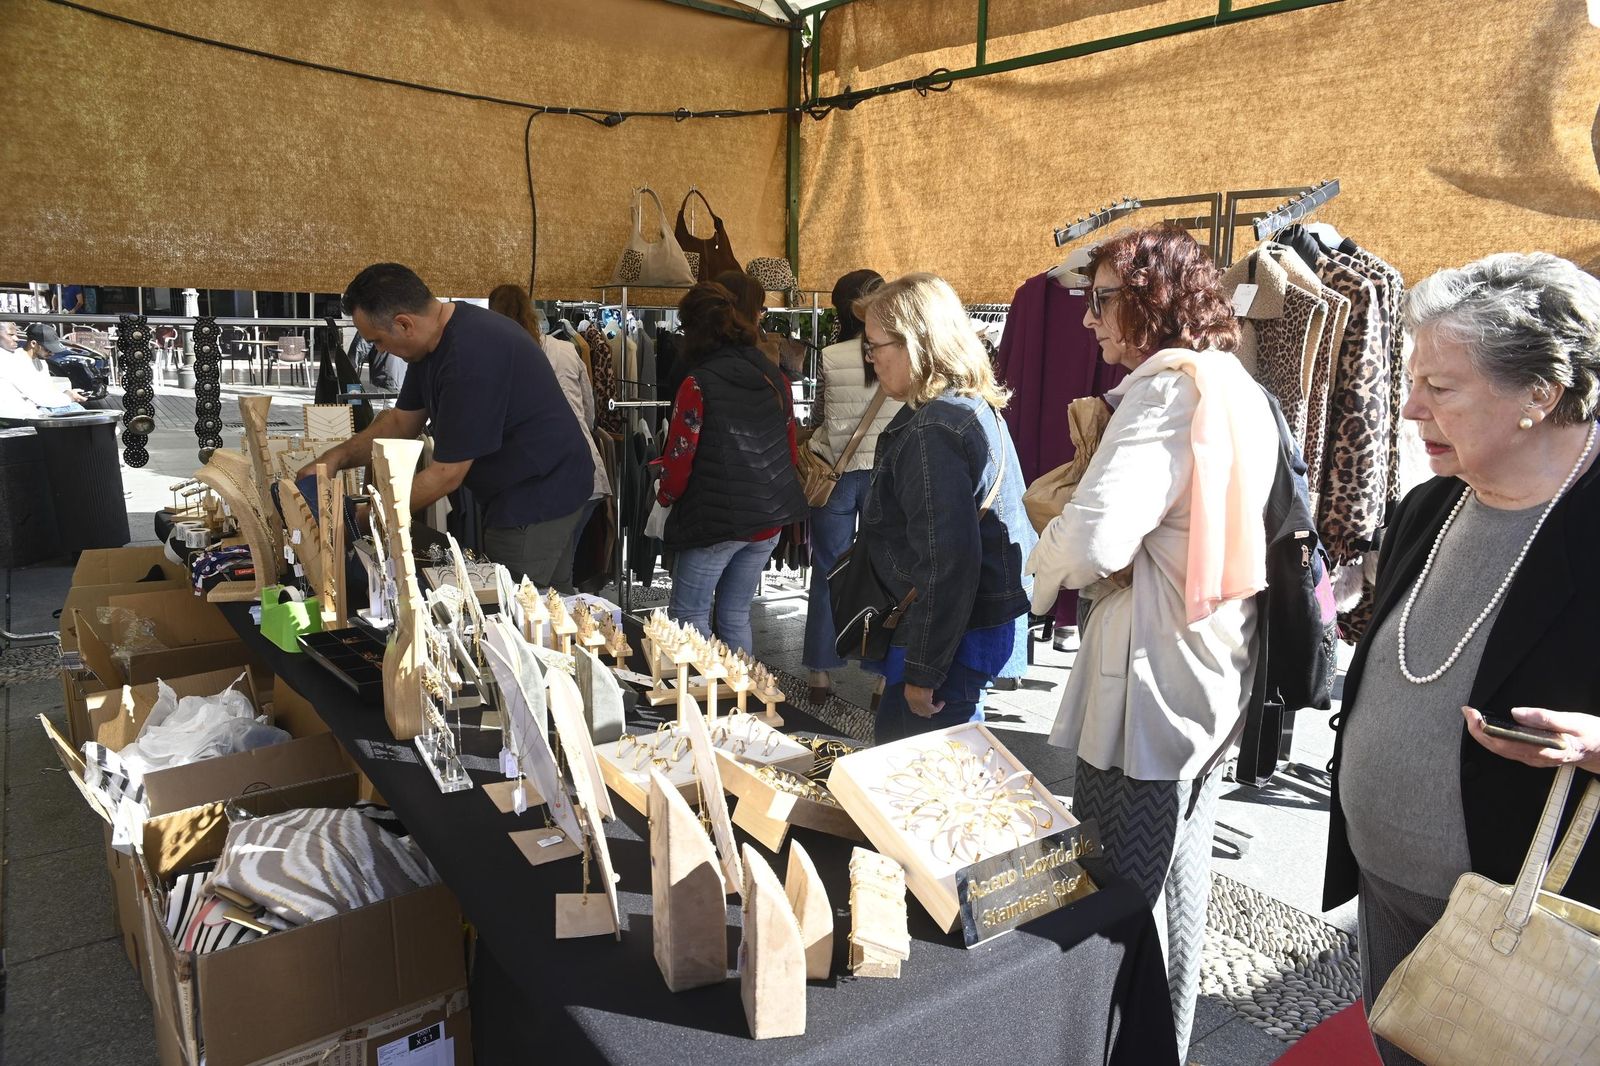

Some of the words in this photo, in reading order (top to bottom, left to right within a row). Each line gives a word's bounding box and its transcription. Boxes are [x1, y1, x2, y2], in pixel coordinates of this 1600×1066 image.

[967, 869, 1017, 901] Acero
[1019, 834, 1095, 879] Inoxidable
[982, 889, 1050, 929] Stainless
[1052, 871, 1090, 897] Steel
